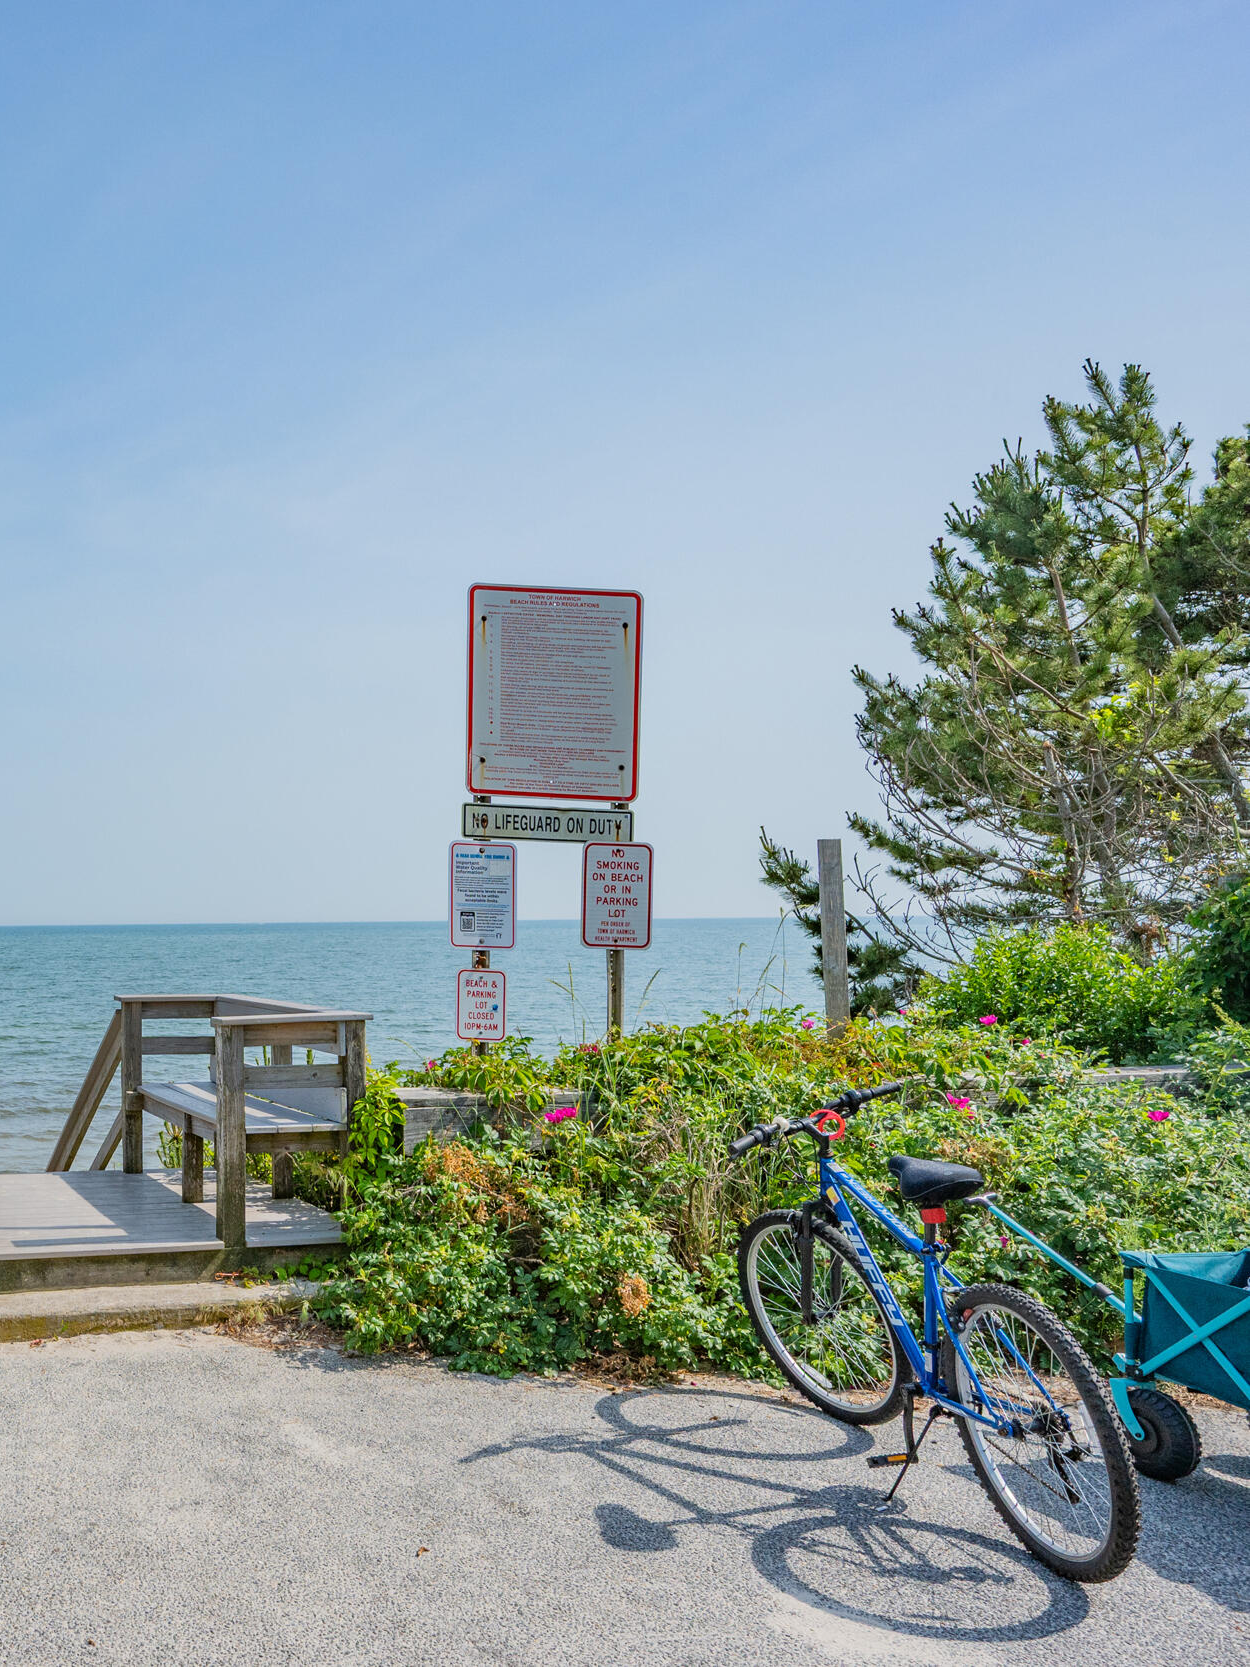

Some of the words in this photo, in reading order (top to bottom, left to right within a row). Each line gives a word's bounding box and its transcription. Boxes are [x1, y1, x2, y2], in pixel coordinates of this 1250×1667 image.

[472, 813, 488, 829] NO
[495, 814, 560, 832] LIFEGUARD
[567, 817, 584, 833] ON
[590, 818, 622, 835] DUTY
[612, 849, 625, 858] NO
[597, 861, 639, 870] SMOKING
[611, 873, 643, 882] BEACH
[604, 885, 616, 893] OR
[596, 897, 638, 906] PARKING
[608, 909, 626, 918] LOT
[466, 979, 488, 988] BEACH
[467, 990, 496, 999] PARKING
[475, 1001, 487, 1009] LOT
[468, 1012, 494, 1020] CLOSED
[464, 1022, 498, 1031] 10PM-6AM
[840, 1220, 904, 1326] HUFFY
